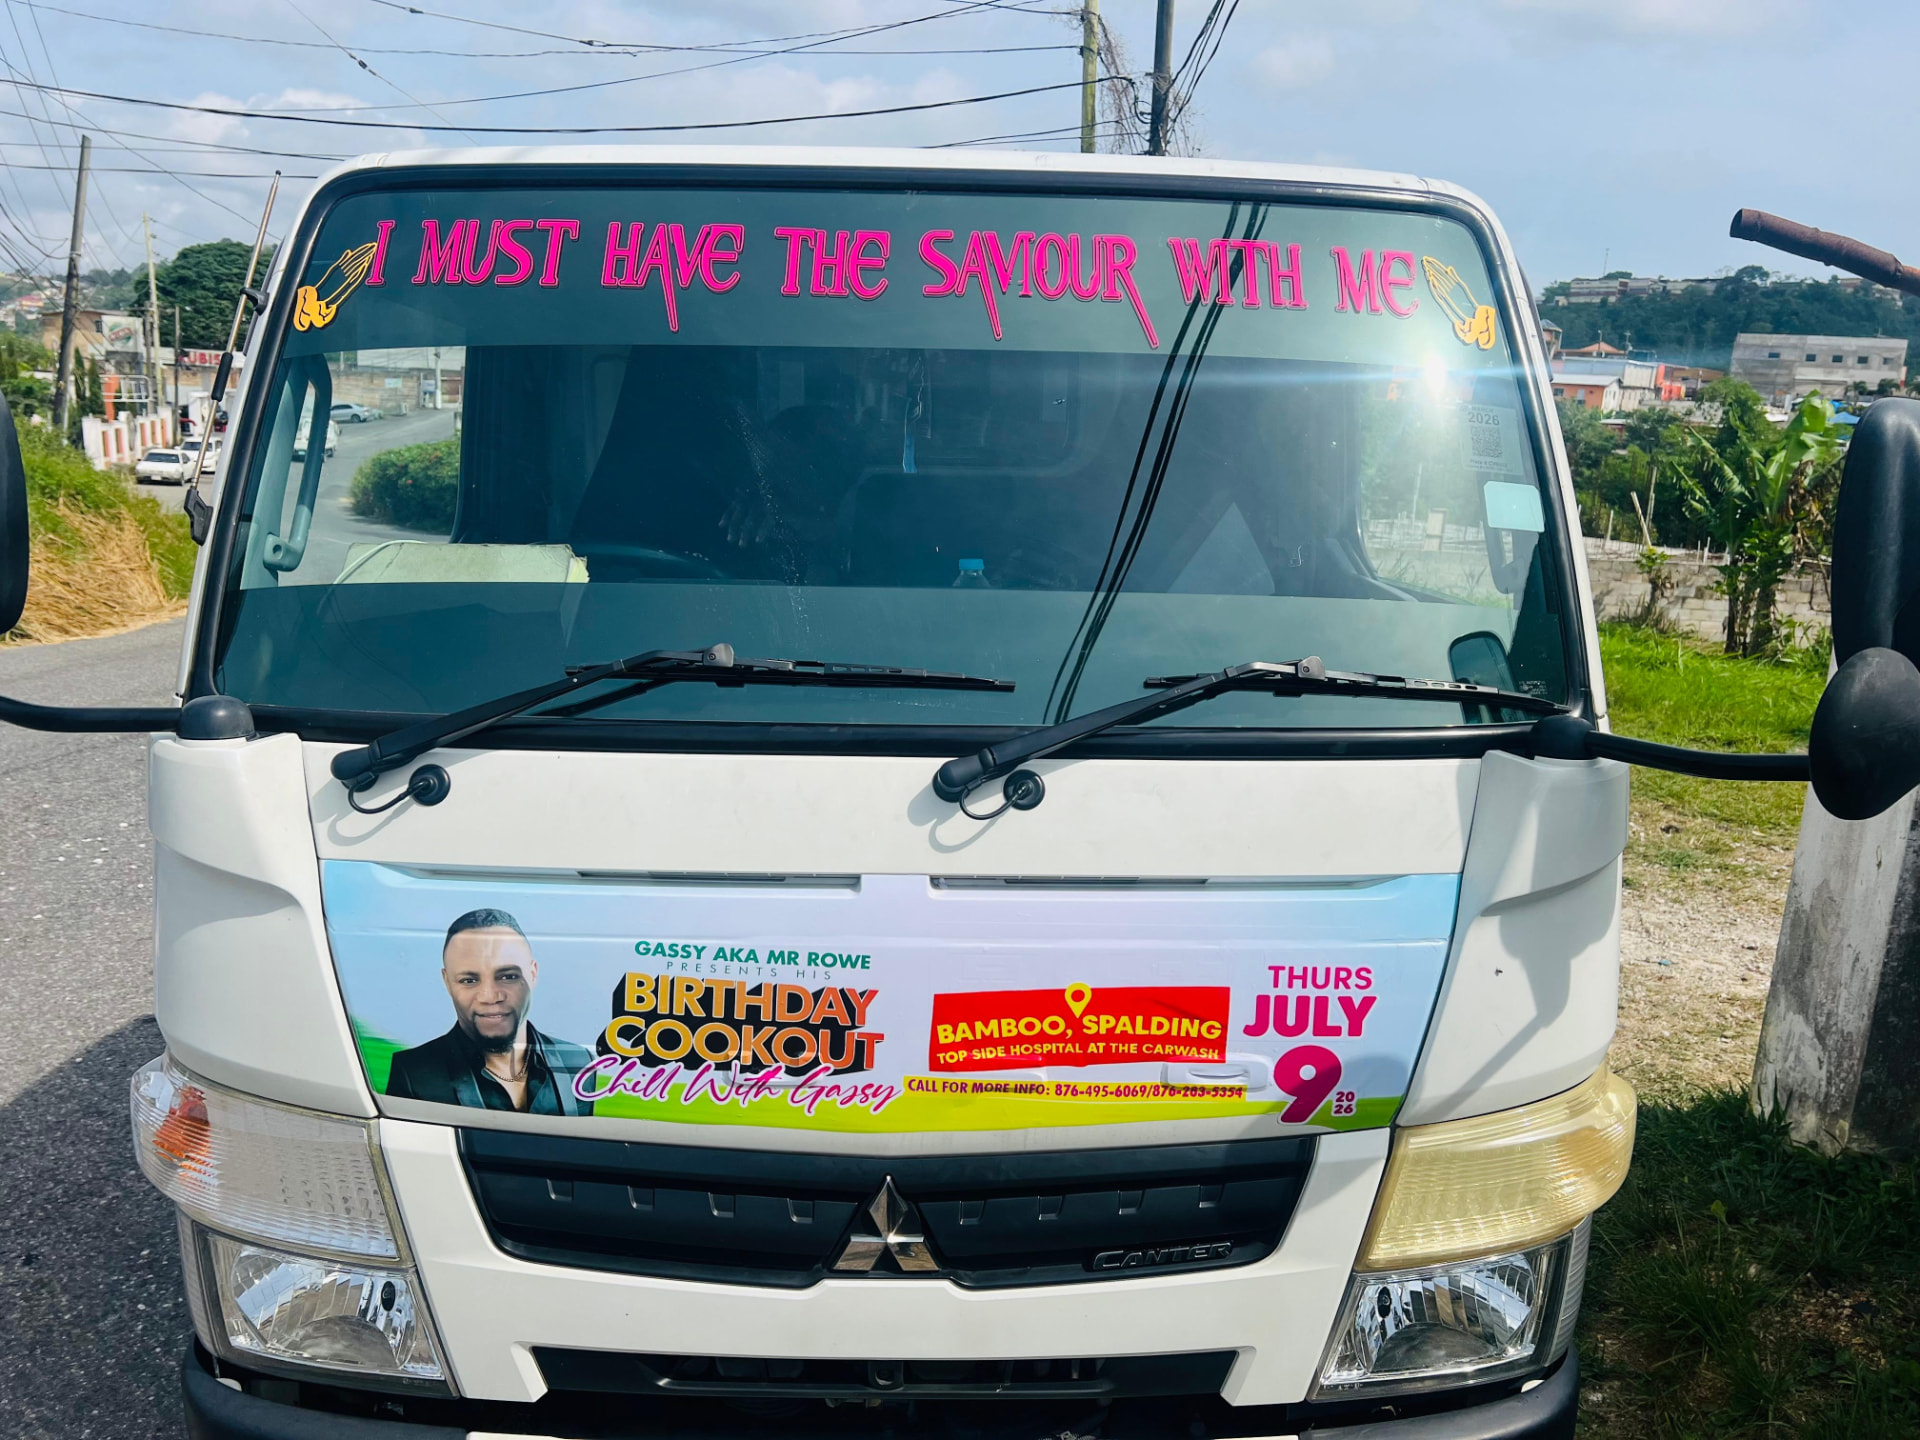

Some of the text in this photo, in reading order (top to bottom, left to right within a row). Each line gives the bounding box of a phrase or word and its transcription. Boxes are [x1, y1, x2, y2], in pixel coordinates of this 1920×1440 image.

[365, 219, 1422, 349] I MUST HAVE THE SAVIOUR WITH ME
[179, 351, 222, 366] UBIS
[1467, 411, 1500, 426] 2026
[634, 940, 871, 970] GASSY AKA MR ROWE
[666, 961, 831, 980] PRESENTS HIS
[1268, 965, 1372, 990] THURS
[620, 972, 879, 1027] BIRTHDAY
[936, 1014, 1222, 1044] BAMBOO, SPALDING
[1242, 994, 1377, 1037] JULY
[604, 1015, 885, 1071] COOKOUT
[937, 1042, 1219, 1064] TOP SIDE HOSPITAL AT THE CARWASH
[574, 1056, 900, 1114] Chill With Gassy
[908, 1079, 937, 1093] CALL
[942, 1081, 968, 1094] FOR
[971, 1083, 1010, 1094] MORE
[1014, 1084, 1050, 1096] INFO:
[1273, 1044, 1342, 1123] 9
[1335, 1091, 1355, 1103] 20
[1333, 1103, 1354, 1115] 26
[1093, 1241, 1232, 1271] CANTER
